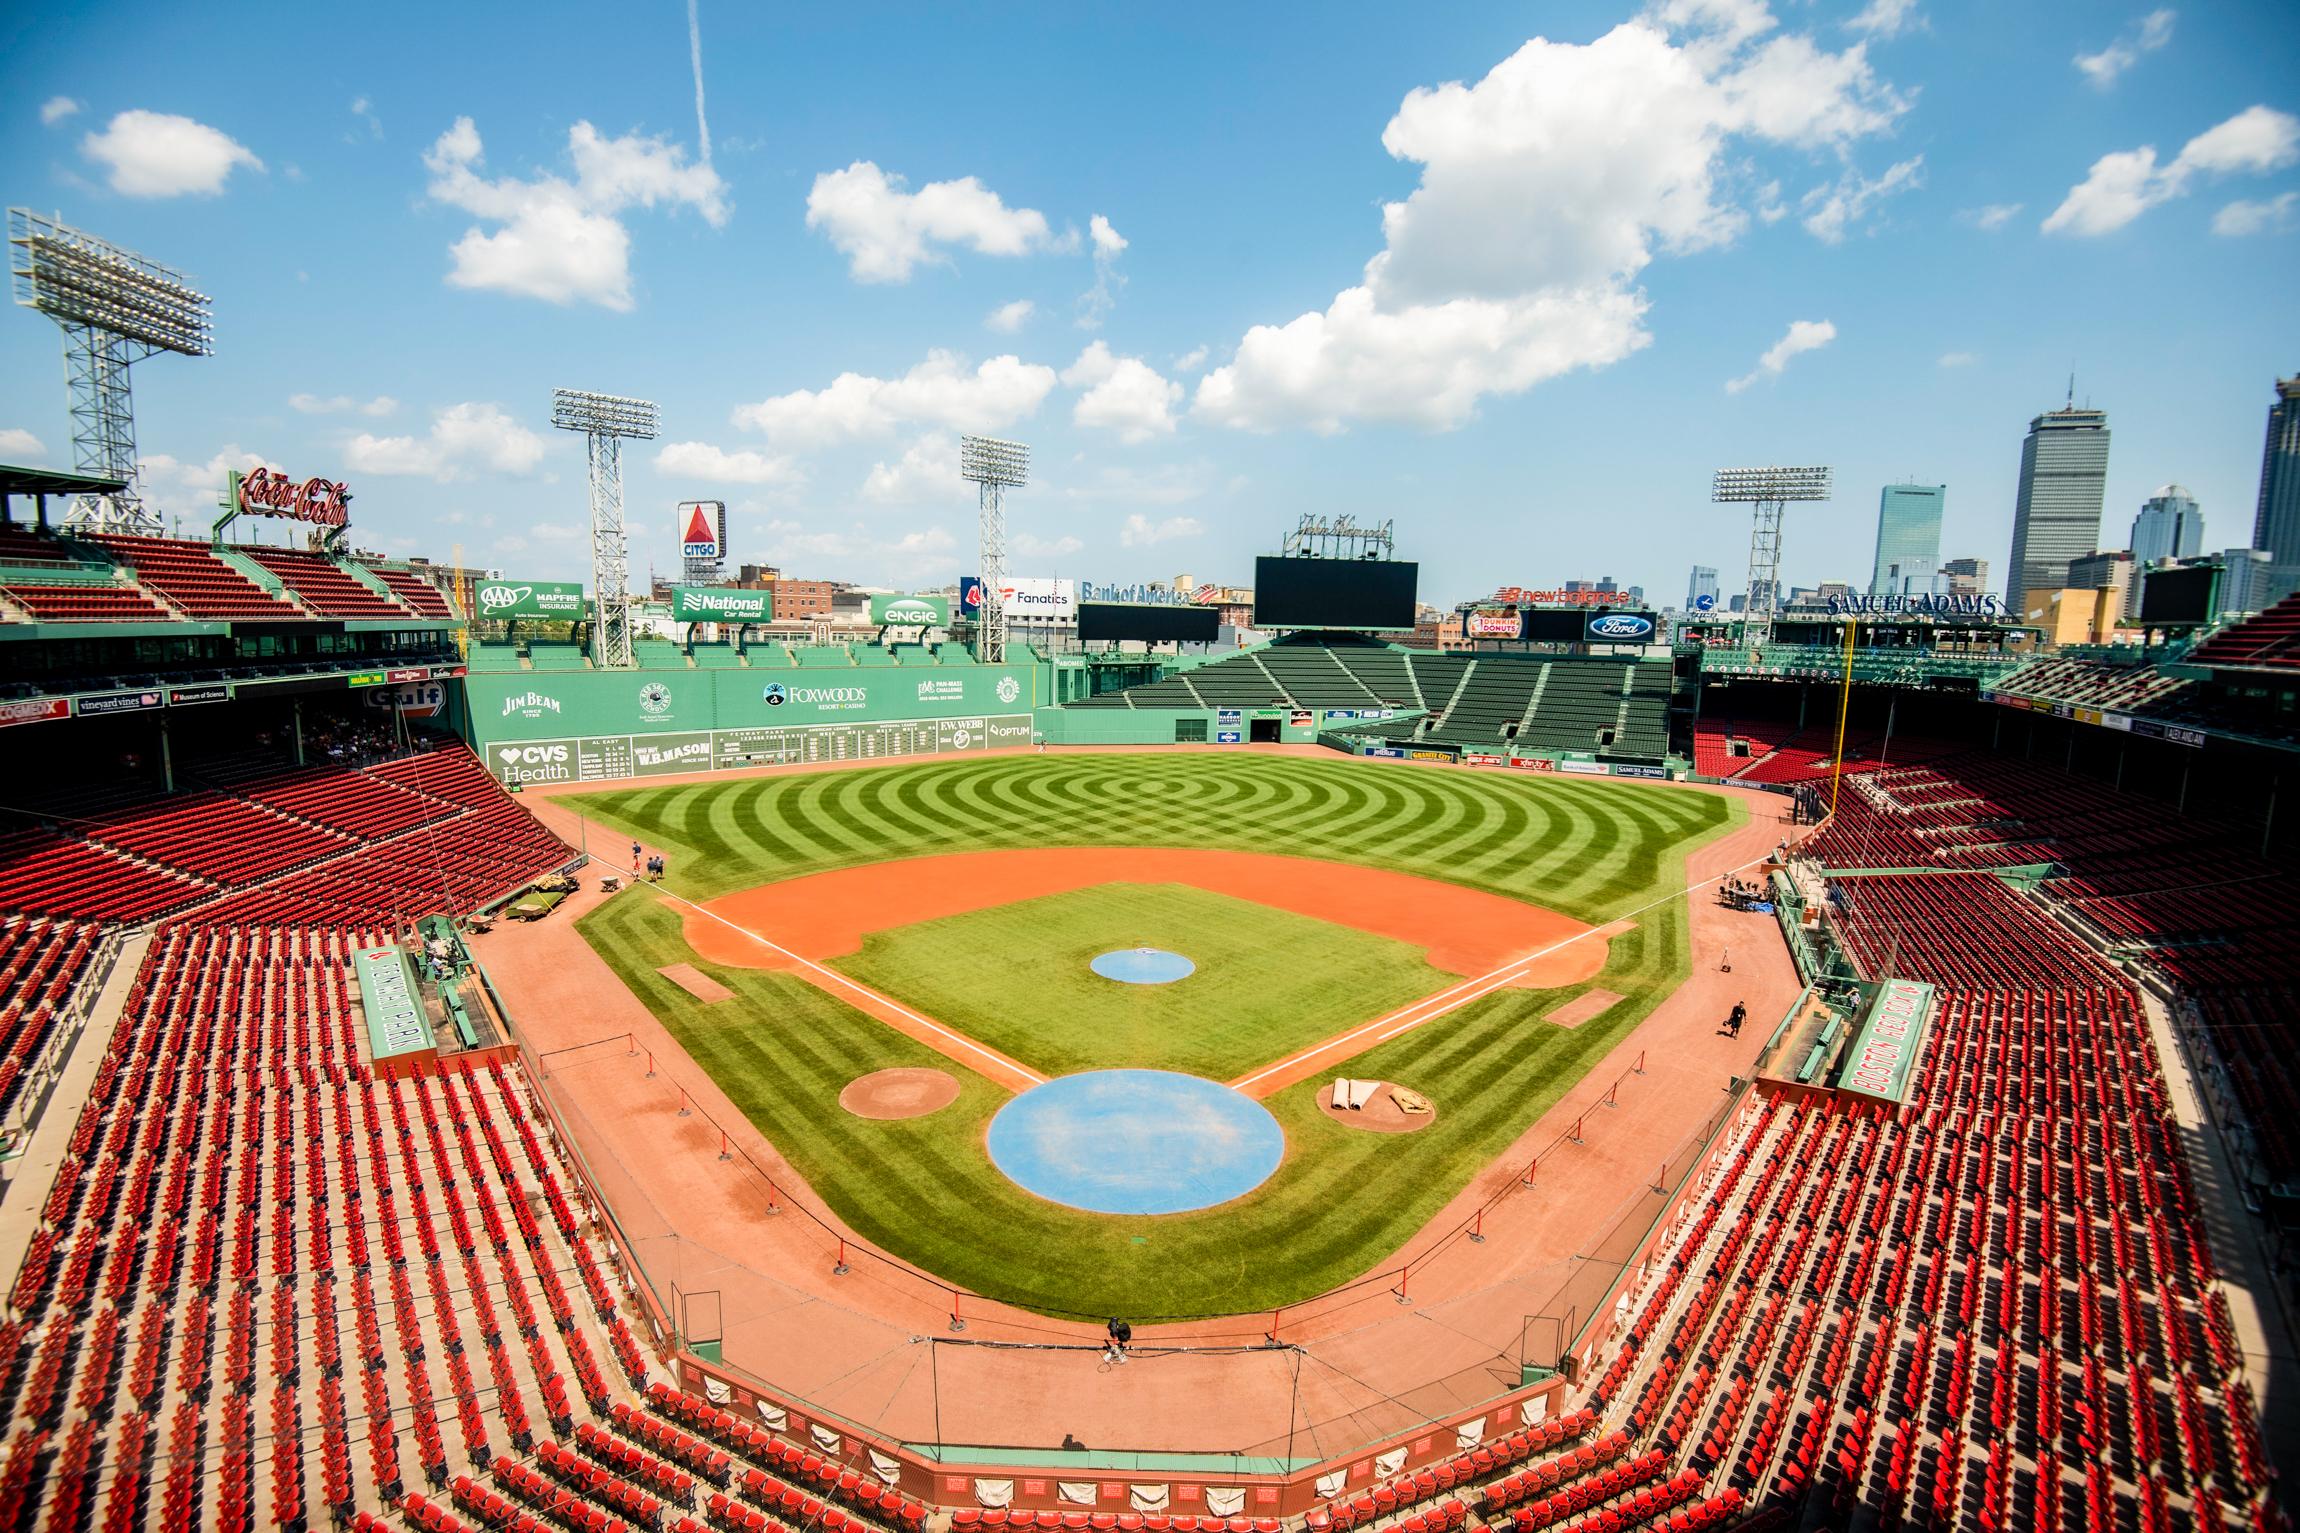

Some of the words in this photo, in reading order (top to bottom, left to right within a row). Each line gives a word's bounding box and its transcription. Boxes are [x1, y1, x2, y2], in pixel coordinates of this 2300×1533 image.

[239, 467, 349, 526] Coca-Cola
[684, 544, 715, 556] CITGO
[486, 587, 514, 606] AAA
[536, 594, 580, 602] MAPFRE
[1017, 591, 1068, 605] Fanatics
[1081, 581, 1119, 602] Bank
[1120, 584, 1136, 602] of
[1136, 585, 1190, 605] America
[1523, 590, 1556, 603] new
[1558, 587, 1630, 604] balance
[1918, 591, 1998, 617] ADAMS
[1601, 618, 1639, 634] Ford
[80, 697, 117, 711] vineyard
[118, 697, 140, 706] vines
[179, 693, 200, 701] Museum
[369, 686, 440, 705] Gulf
[789, 687, 866, 703] FOXWOODS
[502, 696, 525, 717] JIM
[527, 692, 561, 713] BEAM
[958, 720, 984, 730] WEBB
[1000, 726, 1030, 737] OPTUM
[522, 744, 569, 764] CVS
[503, 763, 570, 783] Health
[1618, 766, 1642, 774] SAMUEL
[1642, 767, 1664, 776] ADAMS
[370, 962, 412, 1010] FENWAY
[382, 1010, 424, 1051] PARK
[1850, 1038, 1900, 1094] BOSTON
[1882, 993, 1916, 1017] SOX
